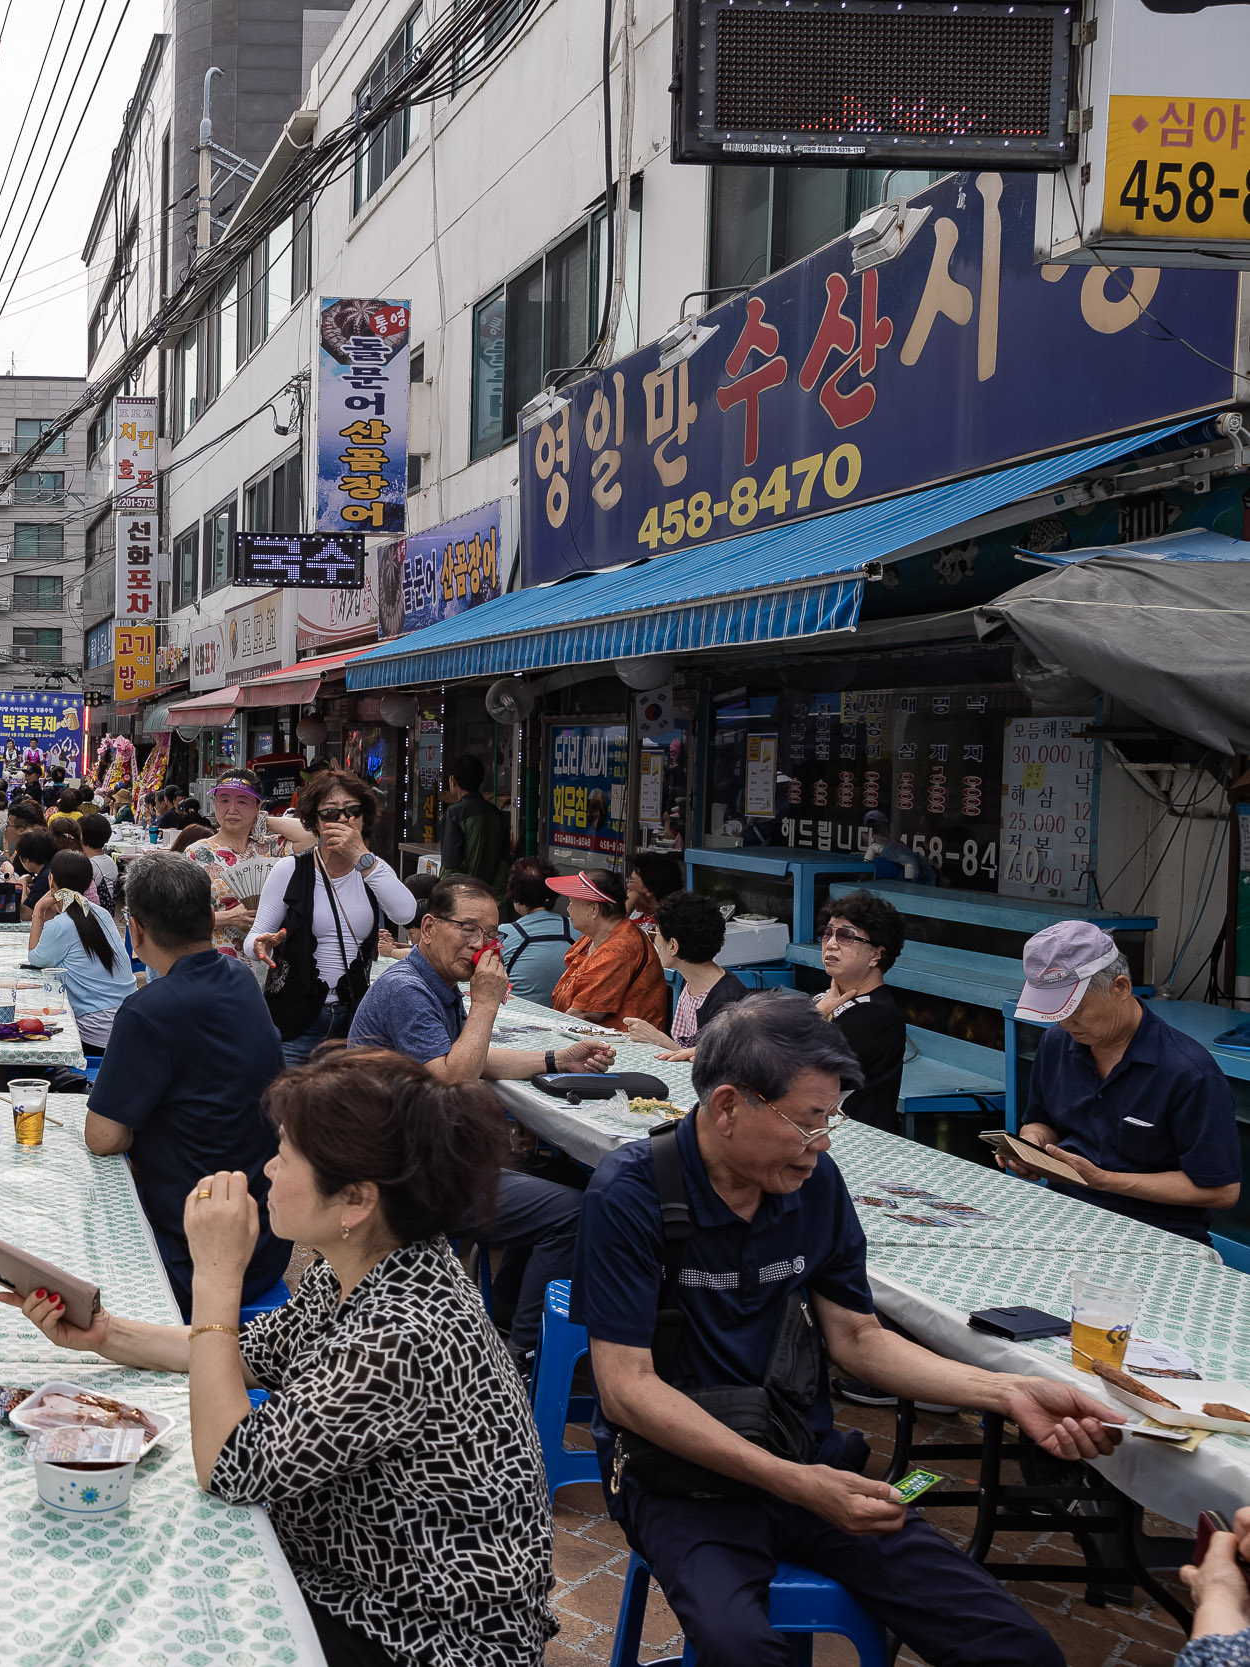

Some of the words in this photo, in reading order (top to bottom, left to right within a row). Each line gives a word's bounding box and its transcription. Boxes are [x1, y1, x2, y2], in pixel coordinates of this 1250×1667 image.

[374, 307, 407, 335] 통영
[341, 336, 393, 416] 돌문어
[119, 422, 154, 450] 치킨
[339, 419, 391, 528] 산꼼장어
[117, 498, 155, 508] 2201-5713
[636, 442, 862, 550] 458-8470
[126, 521, 153, 614] 선화포차
[251, 540, 355, 580] 국수
[440, 526, 497, 601] 산꼼장어
[118, 633, 151, 655] 고기
[136, 656, 151, 667] 먹고
[118, 665, 136, 691] 밥
[2, 714, 57, 733] 맥주축제
[963, 695, 988, 763] 낙지
[1013, 720, 1074, 740] 모듬해물
[1012, 744, 1072, 764] 30.000
[552, 784, 588, 828] 회무침
[781, 816, 875, 852] 해드립니다
[1009, 811, 1066, 834] 25.000
